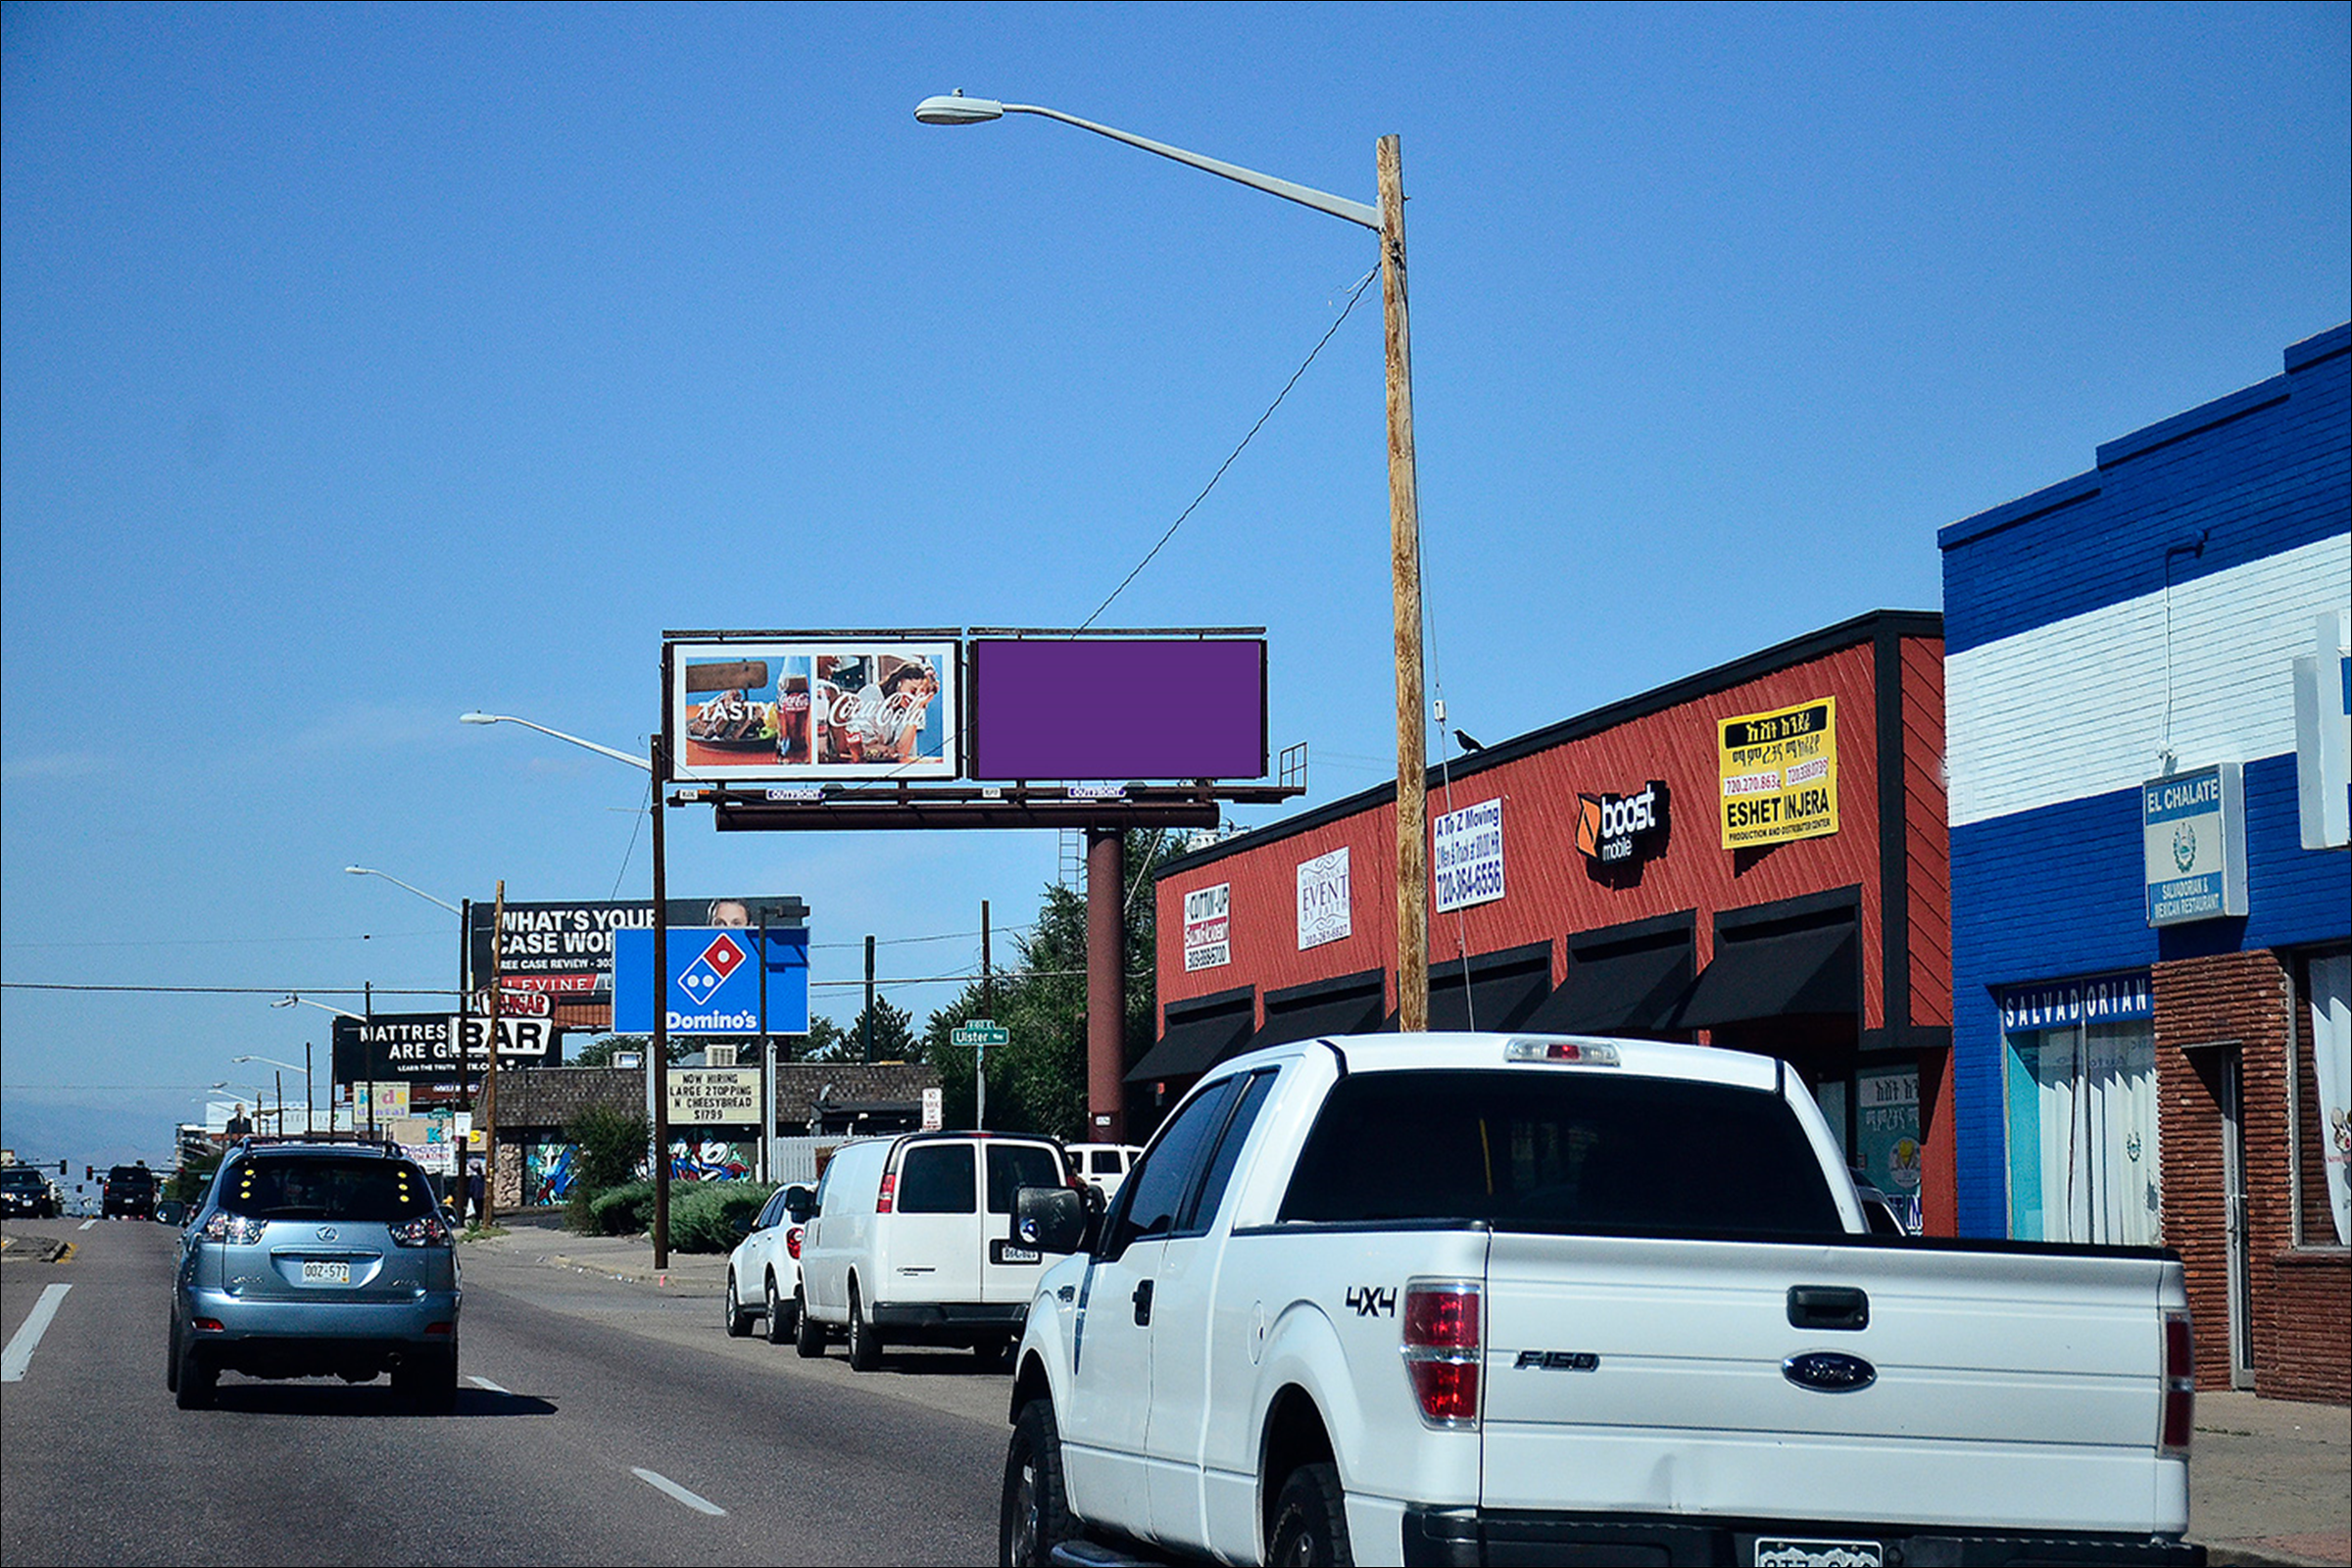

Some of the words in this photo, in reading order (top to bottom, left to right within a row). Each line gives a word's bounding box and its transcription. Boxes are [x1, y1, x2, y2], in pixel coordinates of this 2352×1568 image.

[697, 702, 774, 720] TASTY
[2147, 792, 2163, 813] EL
[2164, 779, 2220, 809] CHALATE
[1601, 784, 1655, 839] boost
[1727, 797, 1782, 827] ESHET
[1785, 788, 1830, 820] INJERA
[1437, 818, 1443, 838] A
[1457, 812, 1464, 832] Z
[1465, 805, 1499, 829] Moving
[1602, 837, 1632, 861] mobile
[1303, 874, 1348, 911] EVENT
[2155, 900, 2180, 919] MEXICAN
[500, 959, 518, 970] REE
[520, 958, 548, 969] CASE
[551, 958, 588, 969] REVIEW
[2006, 978, 2146, 1028] SALVADORIAN
[666, 1009, 758, 1029] Domino's
[360, 1024, 447, 1042] MATTRES
[460, 1022, 540, 1050] BAR
[956, 1031, 988, 1043] Ulster
[389, 1043, 427, 1059] ARE
[682, 1073, 702, 1084] NOW
[707, 1073, 738, 1084] HIRING
[670, 1086, 702, 1097] LARGE
